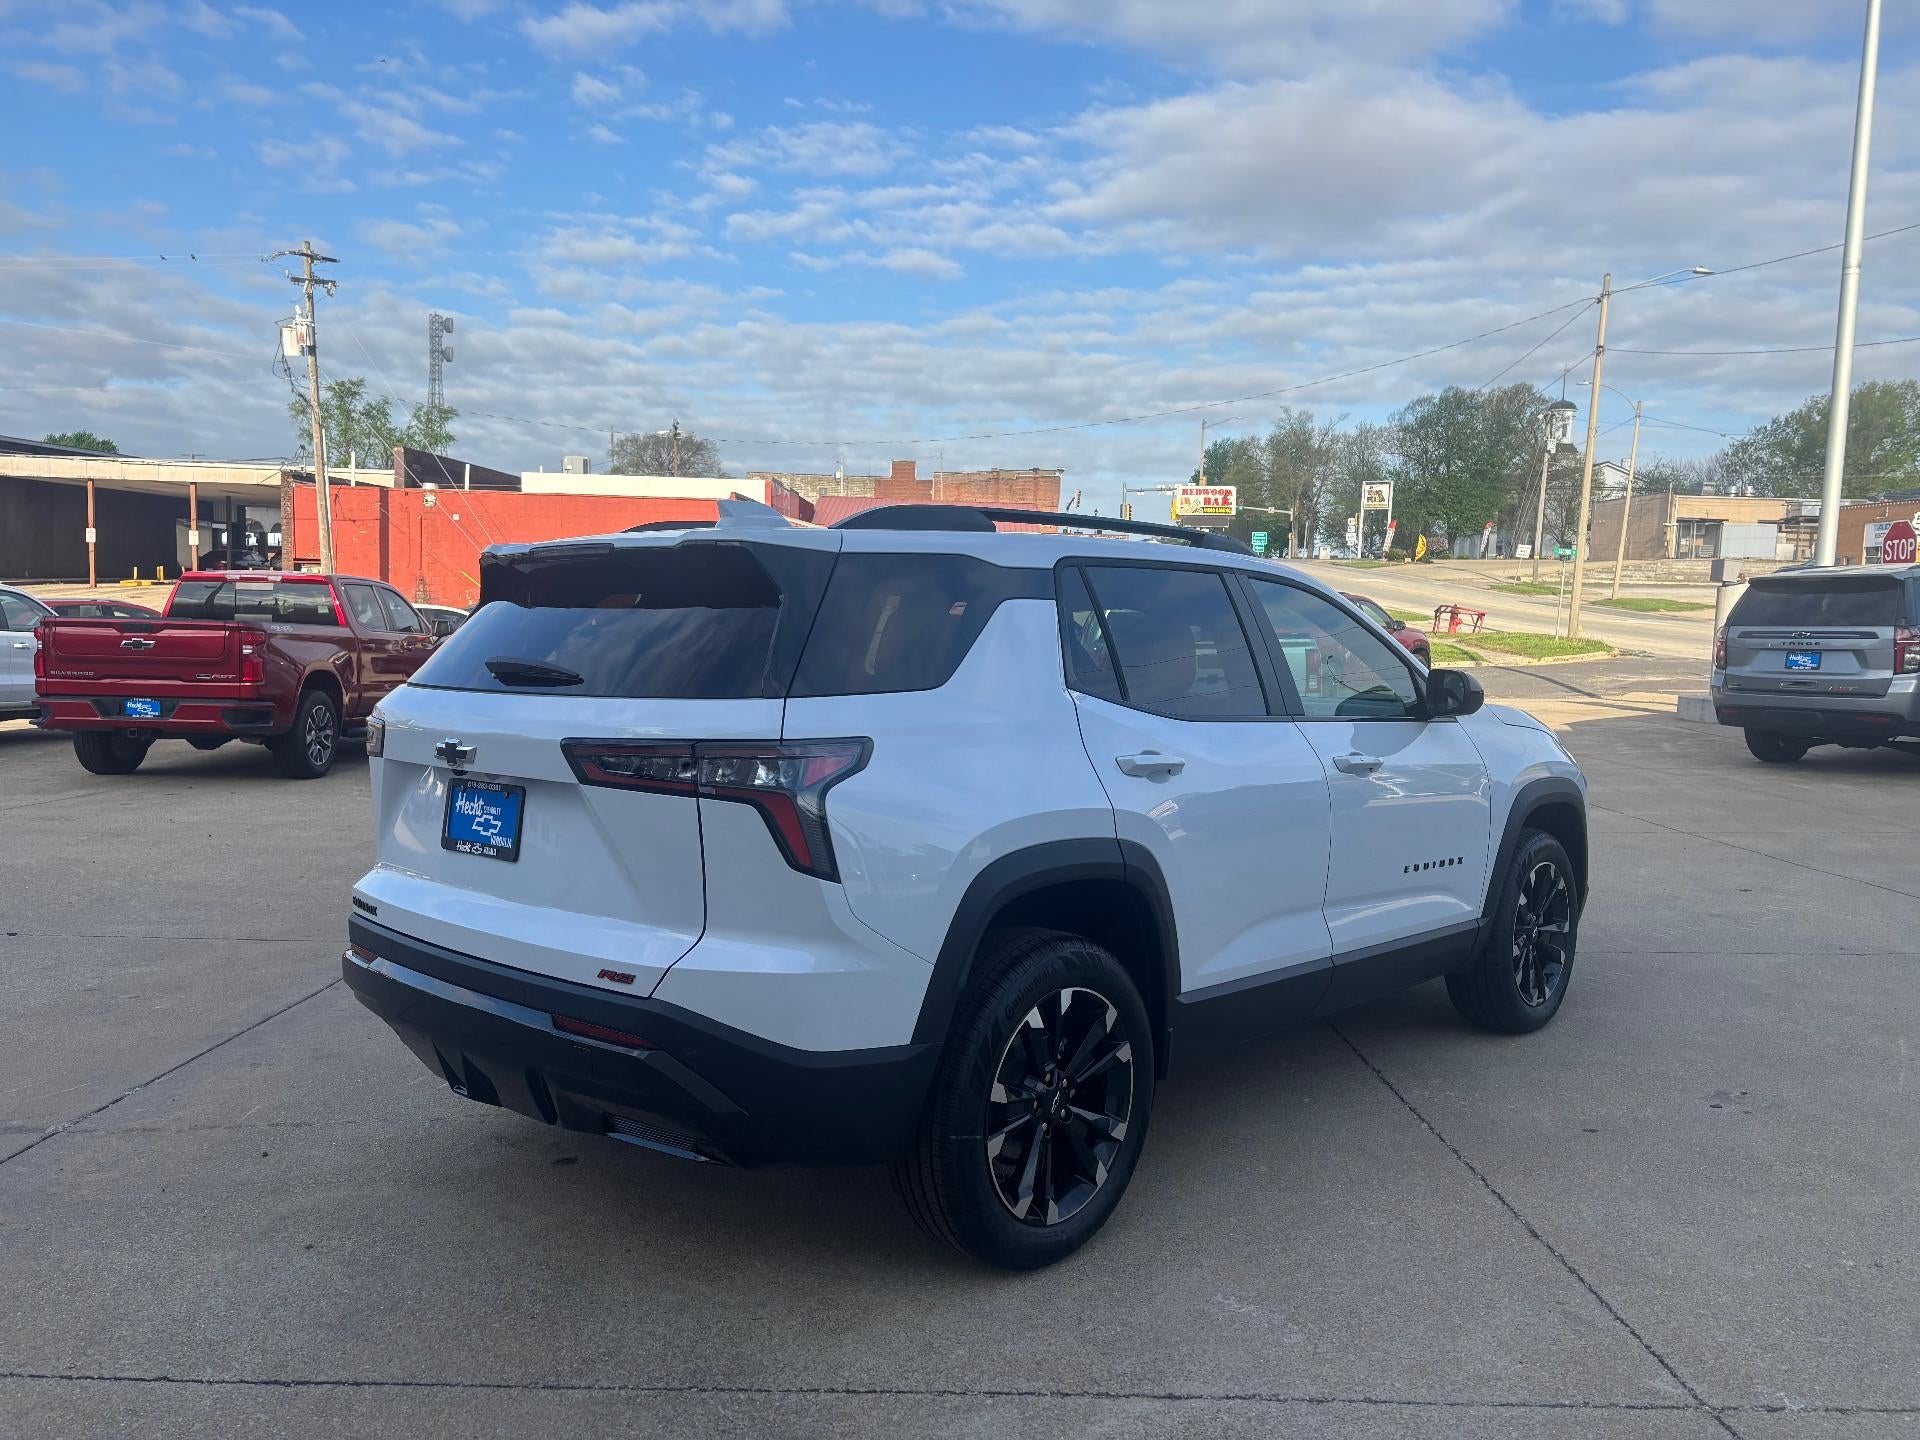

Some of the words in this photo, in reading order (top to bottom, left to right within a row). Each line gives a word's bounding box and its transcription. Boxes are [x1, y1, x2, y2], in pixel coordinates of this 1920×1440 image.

[1181, 488, 1233, 496] REDWOOD
[1203, 497, 1233, 506] BAR
[1884, 538, 1915, 561] STOP
[455, 791, 485, 817] Hecht
[1403, 856, 1464, 874] EQUINOX
[597, 968, 637, 985] RS
